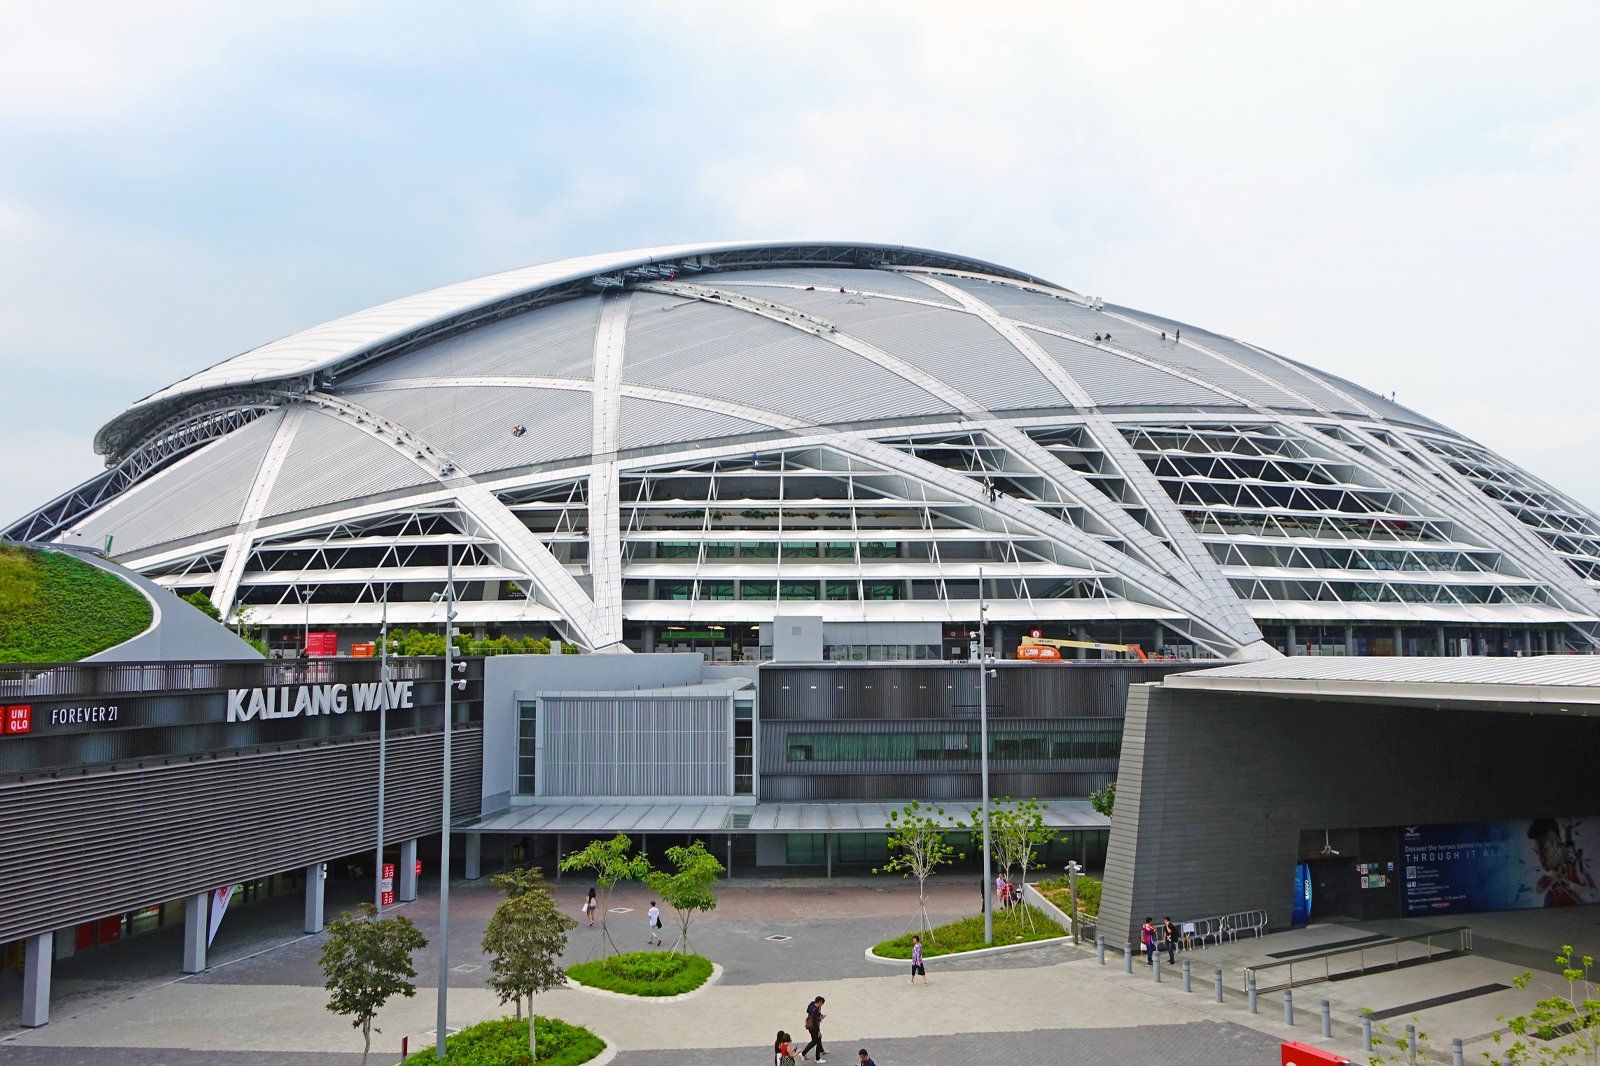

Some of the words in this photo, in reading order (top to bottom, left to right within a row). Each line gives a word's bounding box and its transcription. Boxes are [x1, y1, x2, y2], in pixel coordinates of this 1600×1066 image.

[226, 683, 348, 722] KALLANG
[351, 681, 414, 712] WAVE
[11, 709, 27, 719] UNI
[51, 707, 106, 725] FOREVER
[108, 706, 118, 721] 21
[10, 719, 28, 732] QLO
[1405, 851, 1459, 862] THROUGH
[1466, 850, 1476, 859] IT
